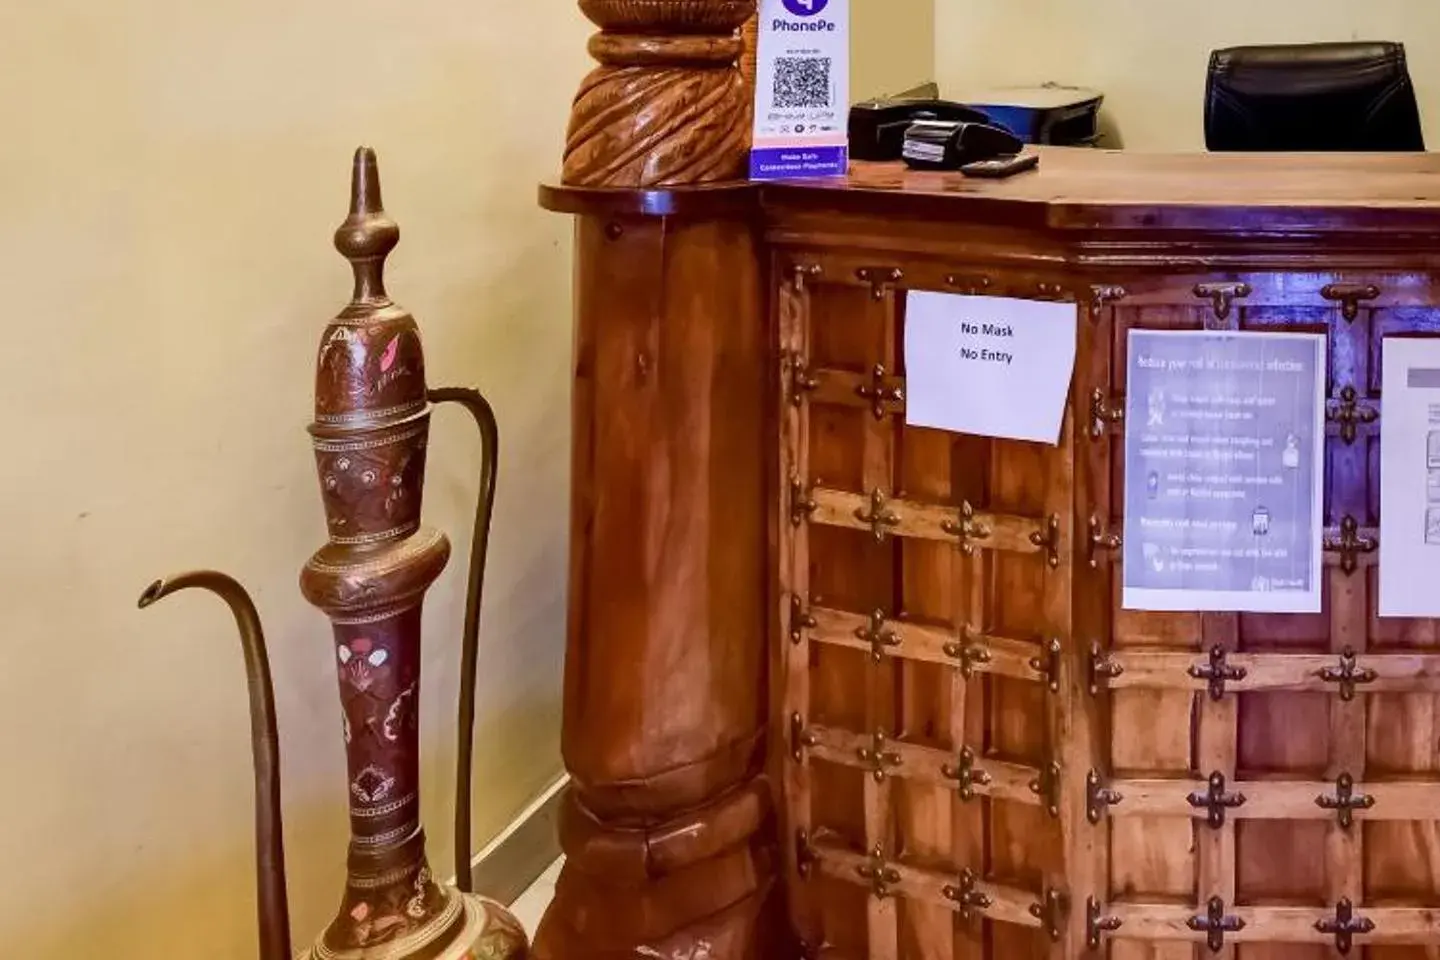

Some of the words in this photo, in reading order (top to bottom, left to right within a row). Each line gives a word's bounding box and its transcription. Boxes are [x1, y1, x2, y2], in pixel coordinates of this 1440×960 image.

[772, 19, 836, 32] PhonePe
[961, 322, 978, 335] No
[982, 323, 1014, 337] Mask
[960, 347, 979, 360] No
[981, 348, 1013, 365] Entry
